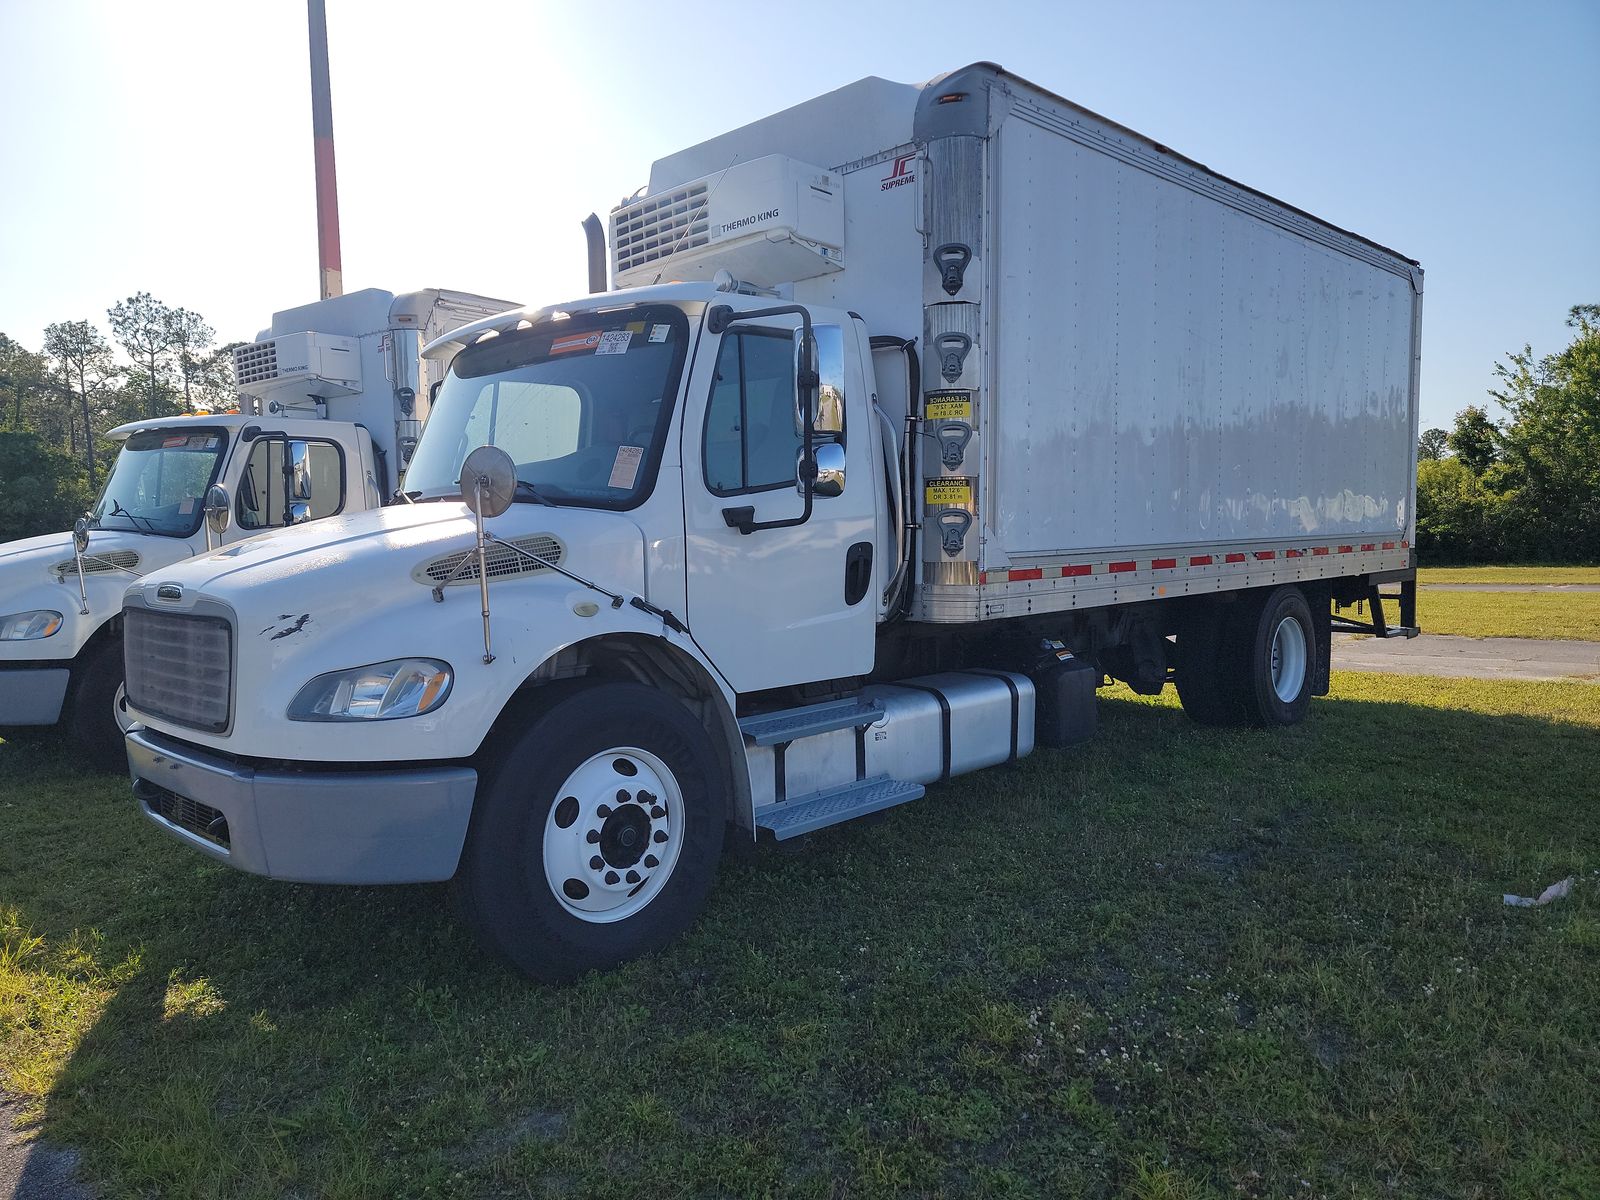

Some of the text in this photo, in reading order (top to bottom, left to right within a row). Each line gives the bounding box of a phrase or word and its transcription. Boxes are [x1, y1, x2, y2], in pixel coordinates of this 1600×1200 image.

[881, 175, 915, 191] SUPREME
[721, 208, 779, 233] THERMO KING
